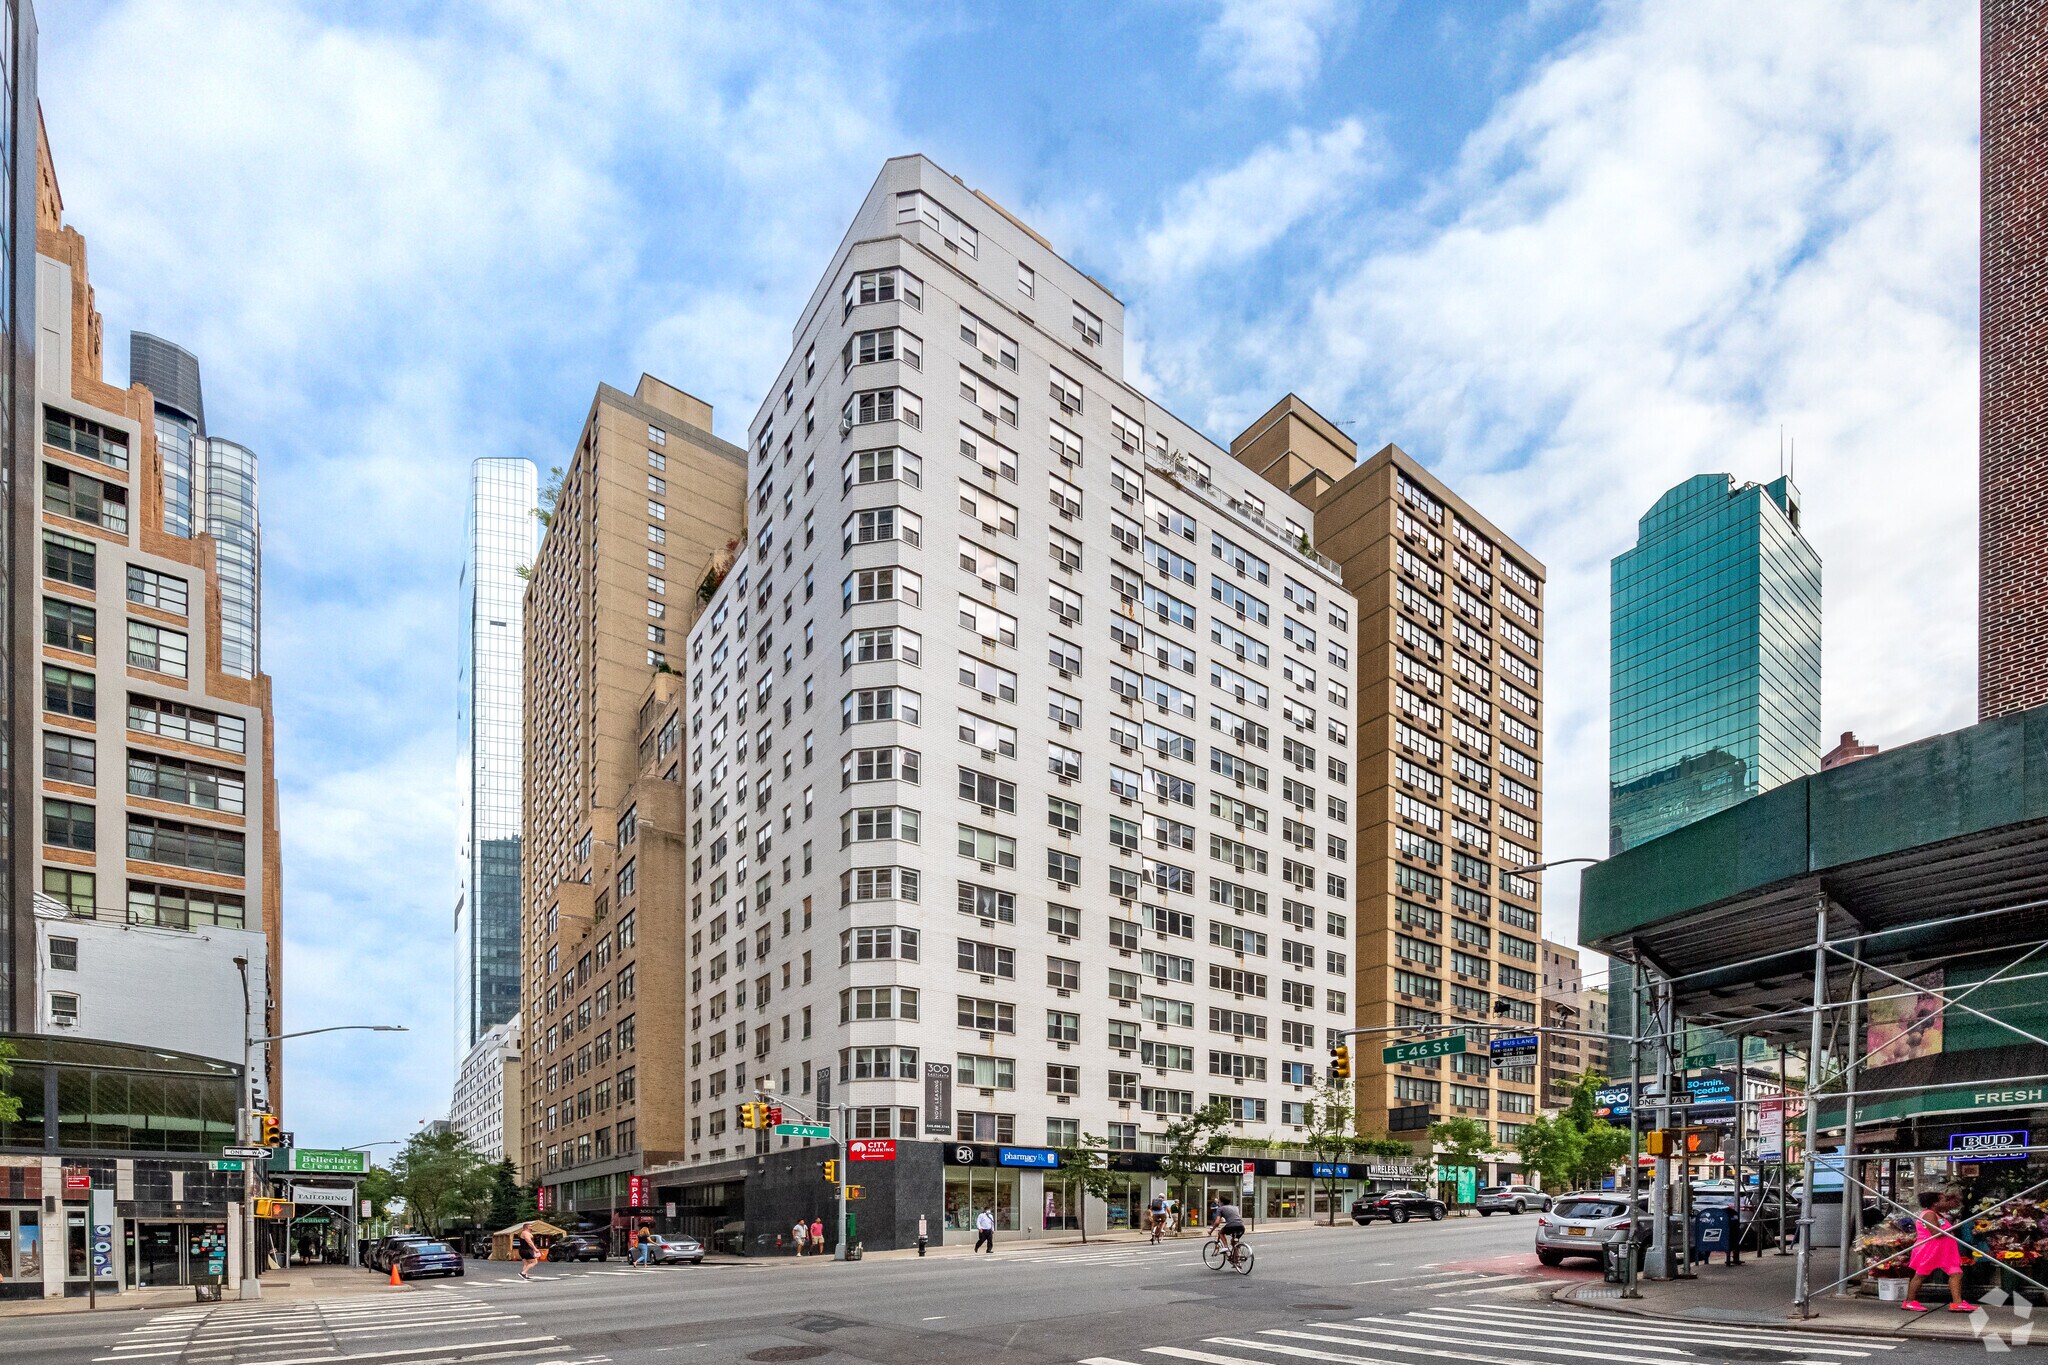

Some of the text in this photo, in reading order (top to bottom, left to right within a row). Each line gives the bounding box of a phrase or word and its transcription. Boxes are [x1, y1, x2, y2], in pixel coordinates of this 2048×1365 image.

[1396, 1042, 1449, 1059] E 46 St
[1692, 1057, 1704, 1066] 46
[928, 1064, 949, 1073] 300
[818, 1069, 829, 1080] 300
[1687, 1079, 1724, 1089] 30-min.
[1595, 1087, 1629, 1096] EMSCULPT
[1595, 1093, 1629, 1105] neo
[1975, 1090, 2042, 1104] FRESH
[1704, 1116, 1737, 1124] OUTFRON
[1963, 1134, 2014, 1148] BUD
[303, 1155, 358, 1164] Belleclaire
[1004, 1152, 1037, 1162] pharmacy
[1370, 1165, 1398, 1175] WIRELESS
[298, 1193, 347, 1201] TAILORING
